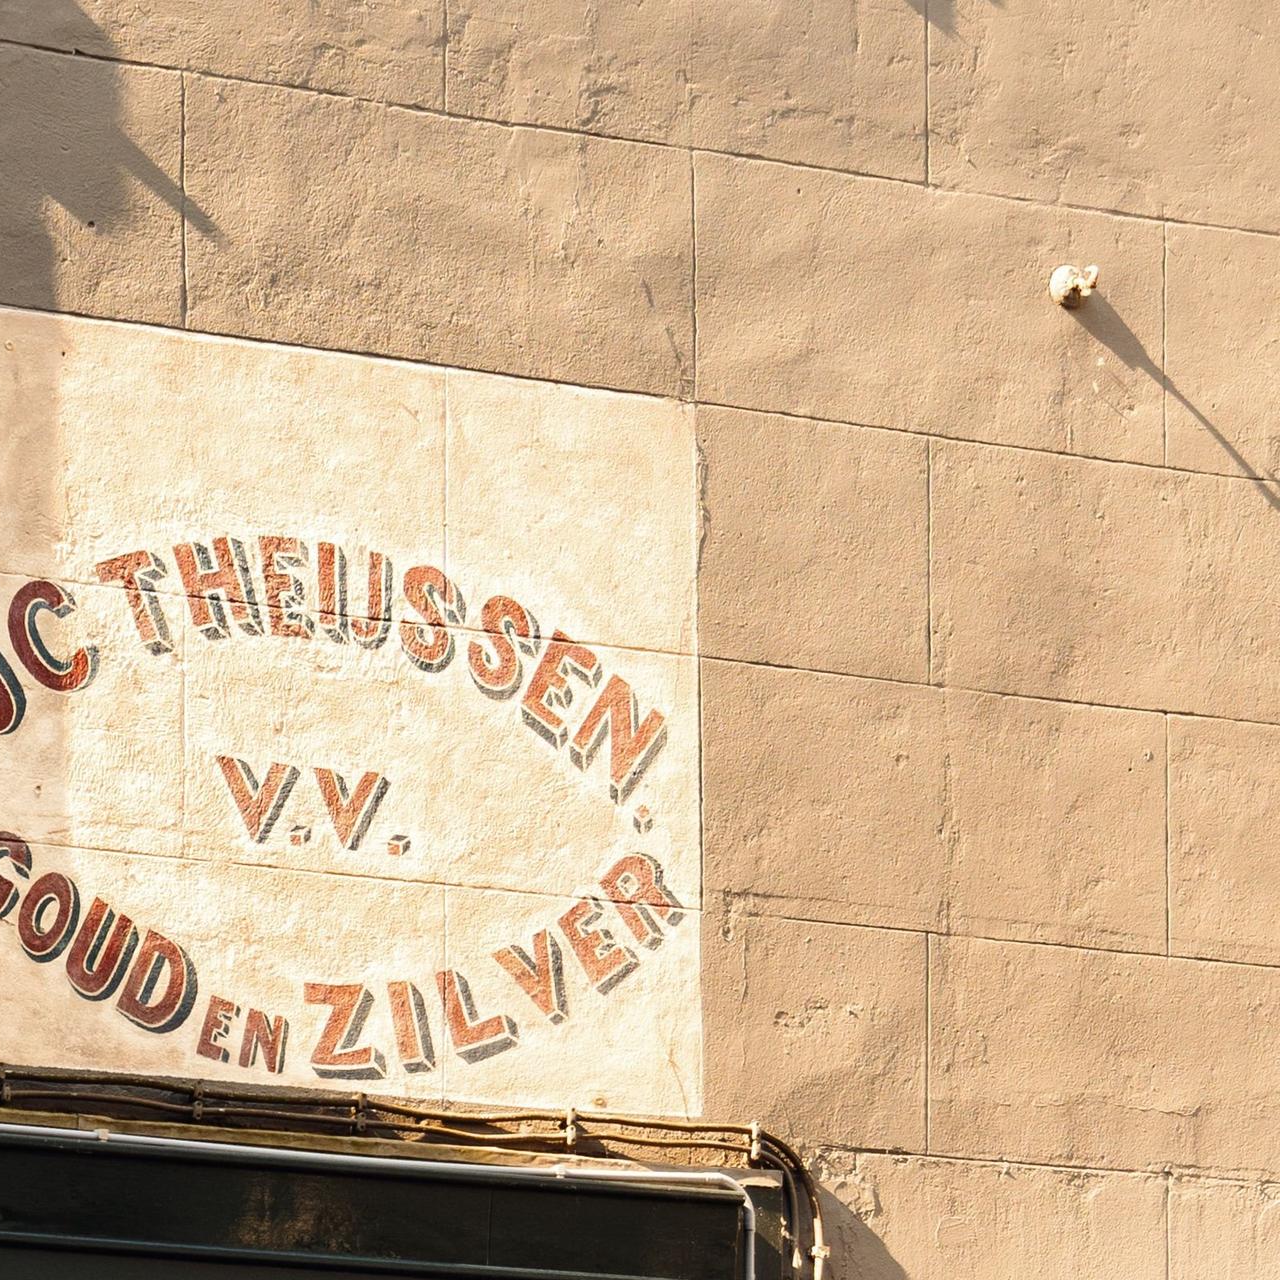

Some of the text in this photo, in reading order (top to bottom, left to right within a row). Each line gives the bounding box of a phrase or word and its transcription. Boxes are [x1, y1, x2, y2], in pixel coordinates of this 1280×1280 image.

[216, 756, 411, 857] V.V.
[196, 996, 288, 1074] EN
[304, 852, 684, 1080] ZILVER
